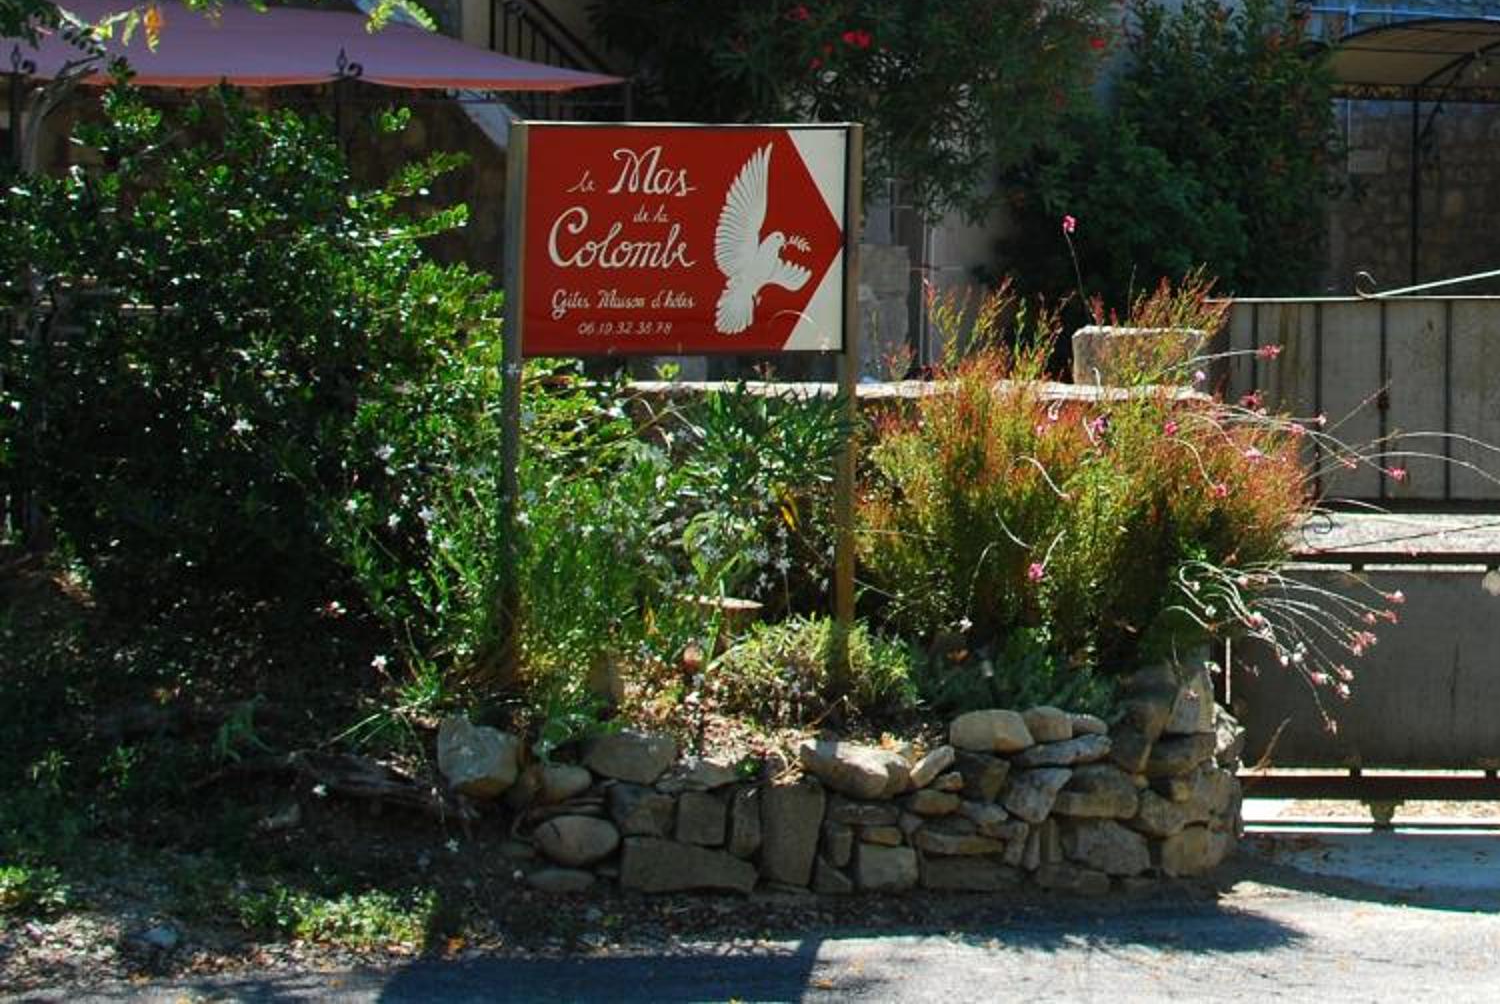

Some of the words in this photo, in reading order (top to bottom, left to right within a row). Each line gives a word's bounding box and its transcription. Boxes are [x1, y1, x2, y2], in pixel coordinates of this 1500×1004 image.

[608, 146, 697, 196] Mas
[633, 204, 649, 223] de
[653, 204, 670, 223] la
[548, 206, 698, 269] Colombe
[597, 288, 646, 309] Maison
